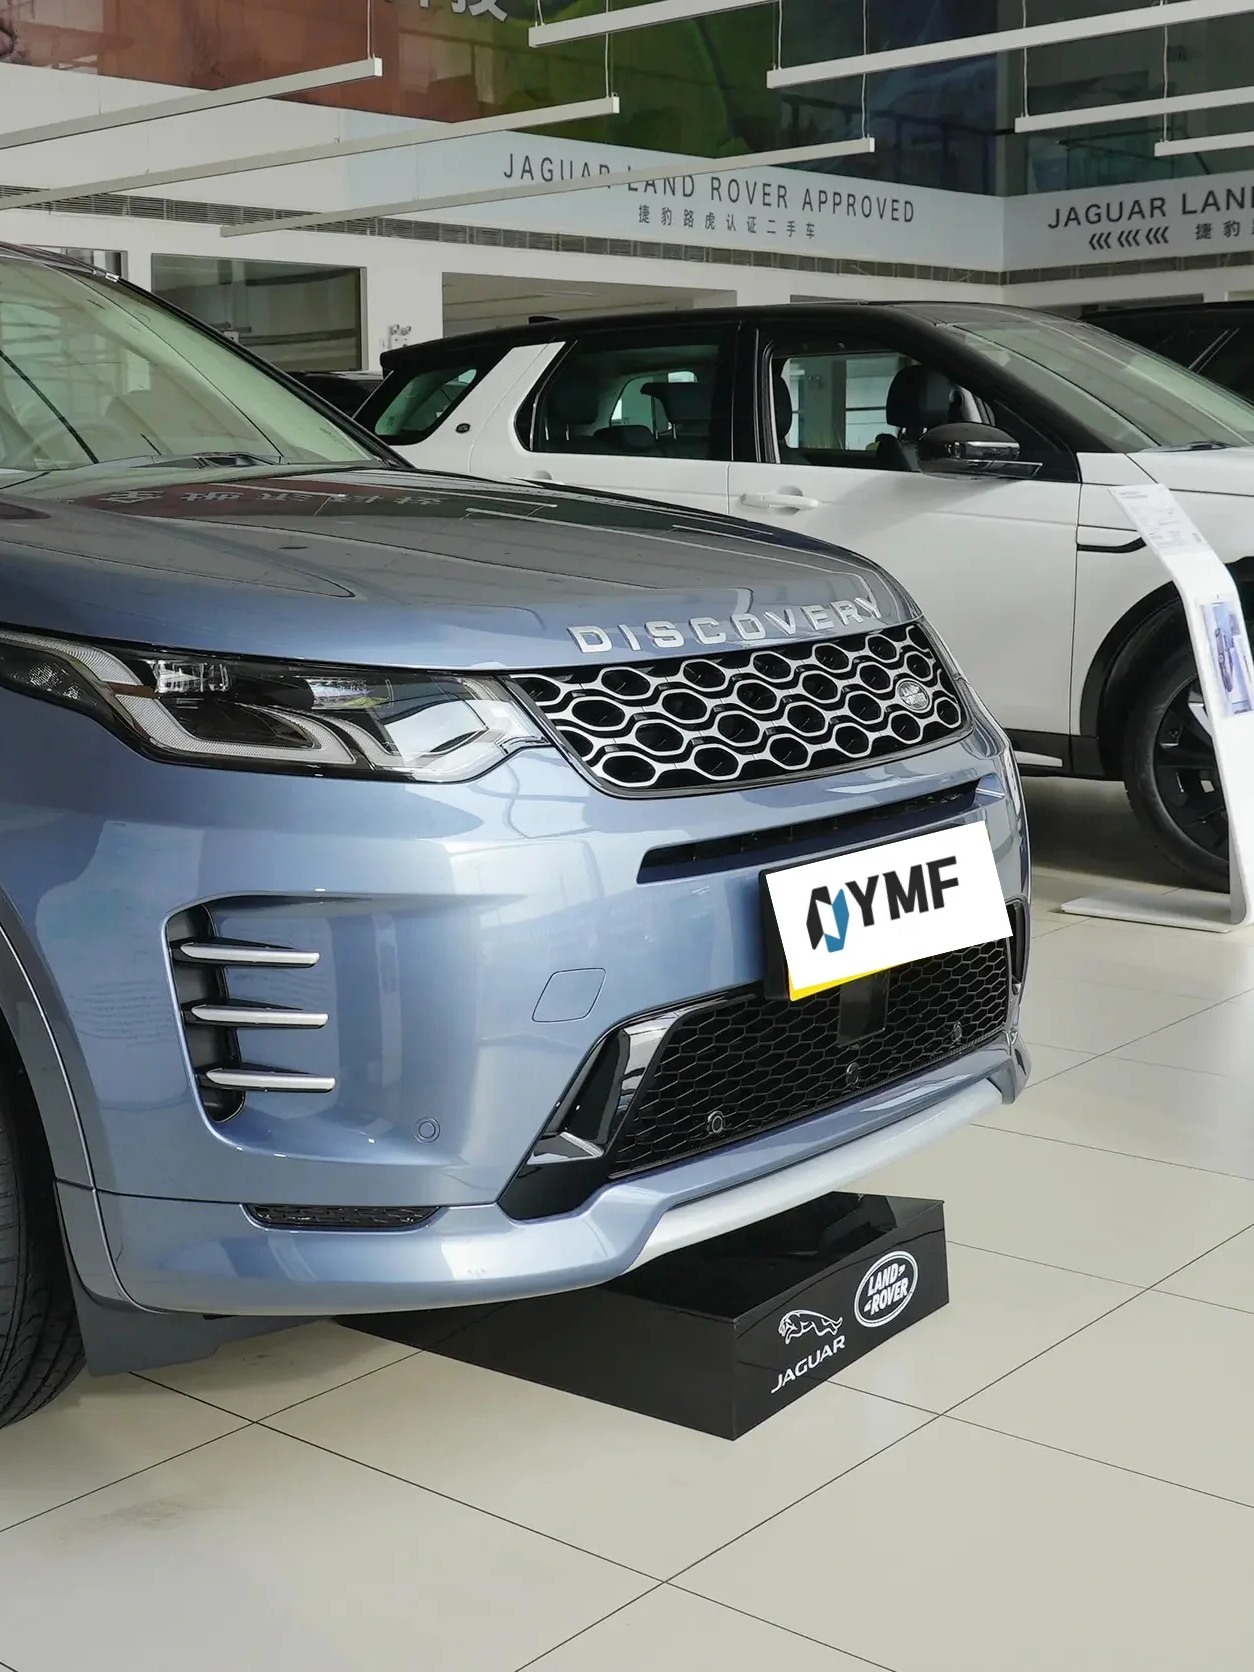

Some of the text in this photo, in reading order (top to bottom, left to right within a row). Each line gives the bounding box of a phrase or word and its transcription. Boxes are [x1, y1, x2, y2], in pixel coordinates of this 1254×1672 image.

[710, 176, 788, 209] ROVER
[801, 188, 914, 223] APPROVED
[1048, 186, 1254, 229] JAGUAR LAN
[638, 203, 815, 239] 捷豹路虎认证二手车
[1194, 219, 1254, 241] 捷豹
[567, 596, 882, 654] DISCOVERY
[867, 1262, 899, 1297] LAND
[870, 1277, 909, 1316] ROVER
[770, 1335, 846, 1394] JAGUAR
